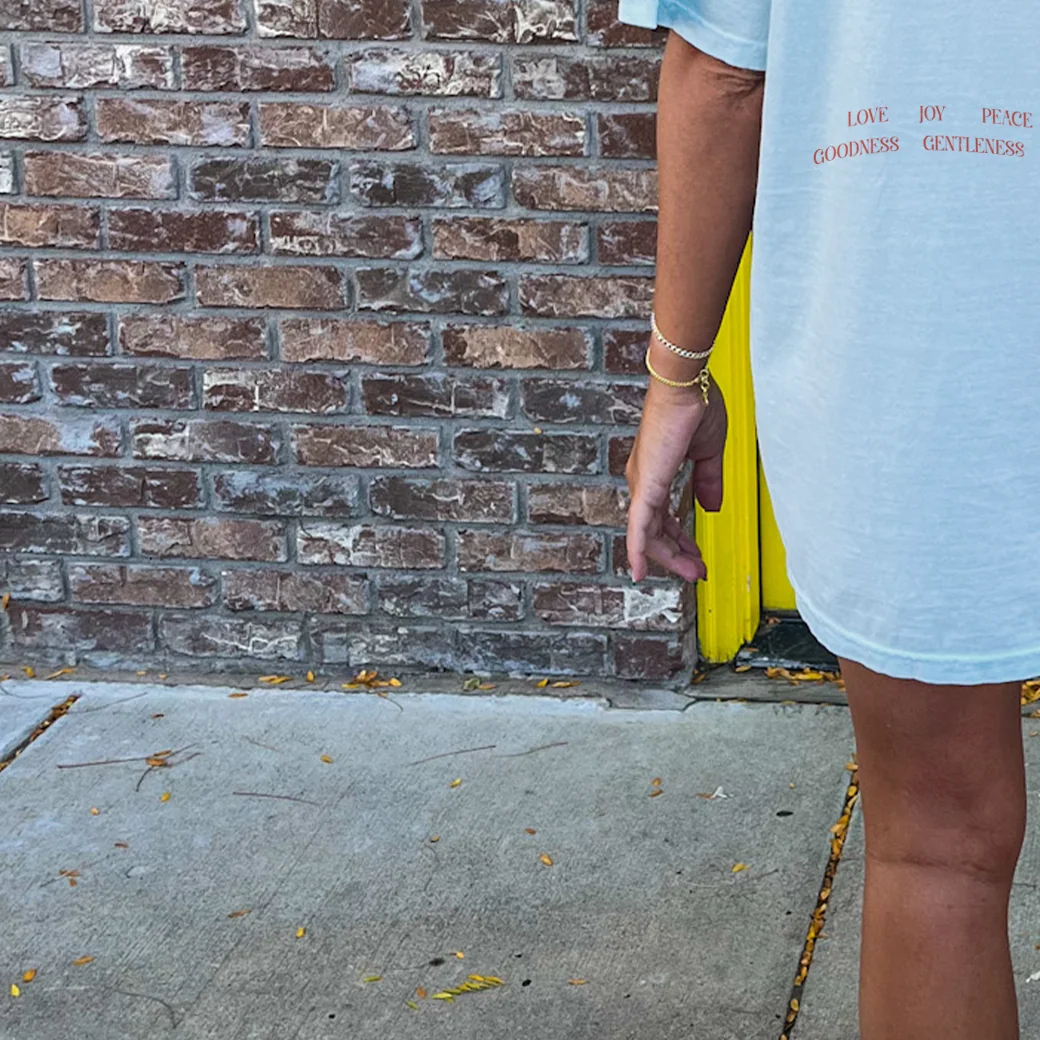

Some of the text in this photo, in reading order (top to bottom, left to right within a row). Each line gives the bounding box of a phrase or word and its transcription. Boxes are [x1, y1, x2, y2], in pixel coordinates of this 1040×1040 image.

[847, 106, 889, 128] LOVE
[919, 105, 946, 124] JOY
[981, 107, 1033, 129] PEACE
[813, 136, 900, 165] GOODNESS
[923, 135, 1025, 158] GENTLENESS
